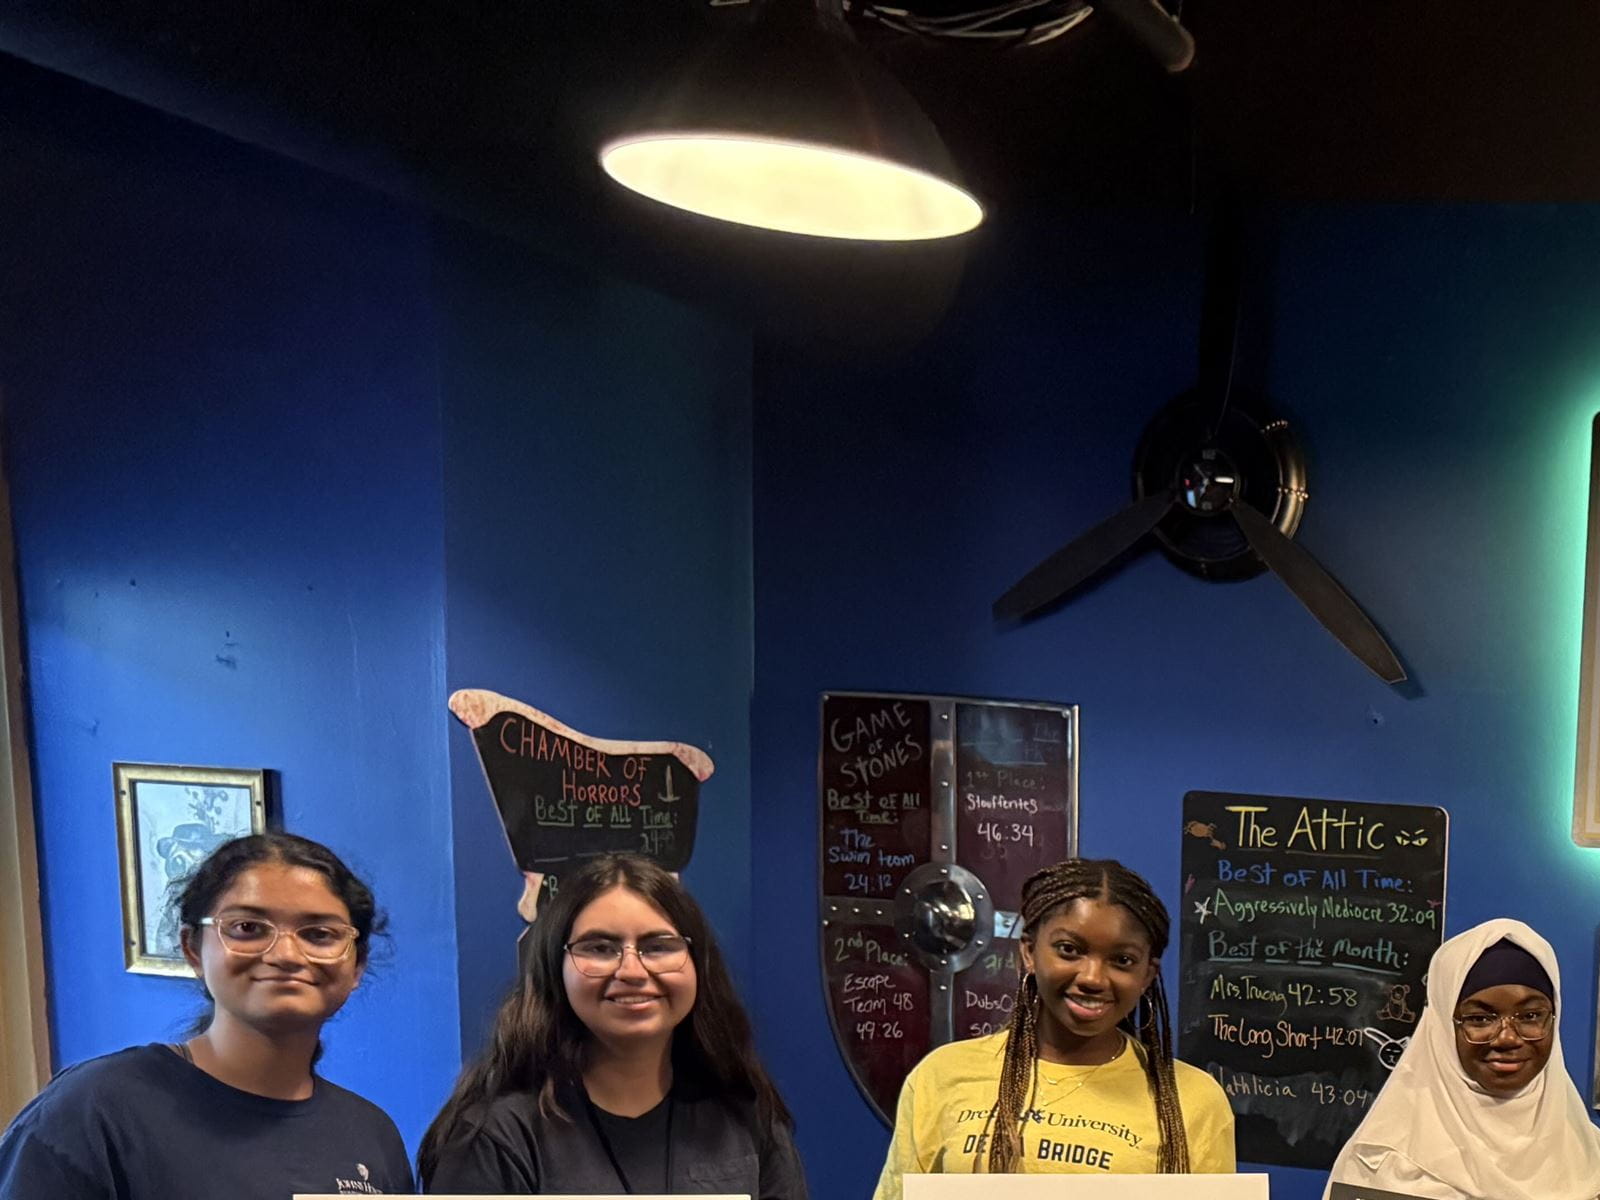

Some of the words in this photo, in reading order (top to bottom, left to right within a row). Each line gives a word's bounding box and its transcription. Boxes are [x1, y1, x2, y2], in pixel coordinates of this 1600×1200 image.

[830, 702, 912, 752] GAME
[500, 718, 611, 778] CHAMBER
[624, 757, 652, 781] OF
[840, 734, 922, 786] STONES
[840, 828, 876, 848] The
[977, 823, 1034, 847] 46:34
[1225, 805, 1279, 848] The
[1287, 806, 1385, 850] Attic
[1218, 859, 1277, 885] Best
[1322, 869, 1346, 890] All
[1355, 869, 1413, 893] Time:
[1214, 887, 1318, 929] Aggressively
[1322, 896, 1384, 922] Mediocre
[1387, 903, 1436, 930] 32:09
[834, 931, 863, 961] 2nd
[865, 940, 908, 966] Place:
[1208, 930, 1259, 957] Best
[1332, 939, 1410, 968] Month:
[843, 973, 896, 994] Escape
[1210, 974, 1242, 1000] Mrs.
[1288, 983, 1358, 1007] 42:58
[843, 996, 887, 1015] Team
[893, 993, 914, 1011] 48
[857, 1021, 903, 1040] 49:26
[1208, 1014, 1238, 1042] The
[1239, 1018, 1274, 1058] Long
[1276, 1021, 1322, 1050] Short
[1311, 1082, 1369, 1108] 43:04
[1048, 1111, 1143, 1148] University
[1037, 1139, 1115, 1171] BRIDGE
